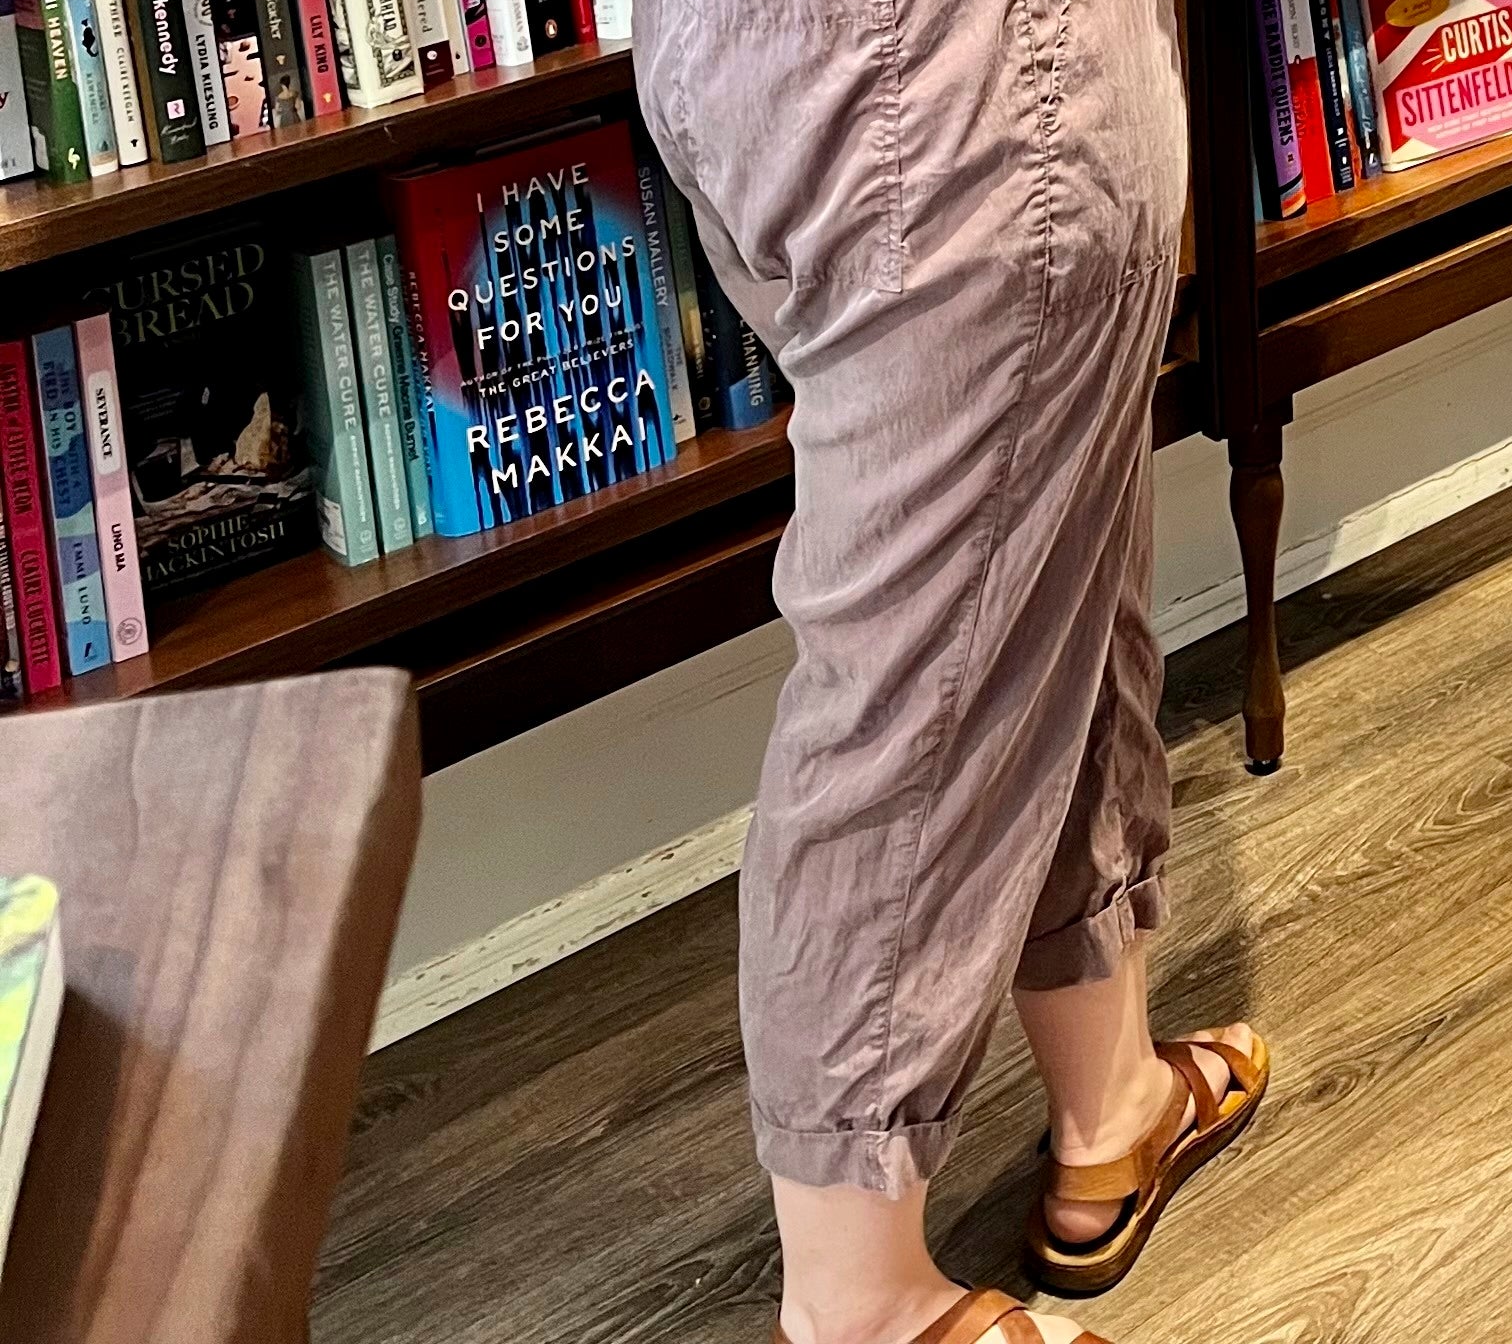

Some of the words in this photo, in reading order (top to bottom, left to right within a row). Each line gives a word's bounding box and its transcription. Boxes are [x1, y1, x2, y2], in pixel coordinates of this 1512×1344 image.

[47, 17, 68, 81] HEAVEN
[152, 0, 177, 76] kennedy
[1272, 86, 1294, 147] QUEENS
[476, 192, 484, 213] I
[502, 162, 590, 206] HAVE
[493, 208, 586, 253] SOME
[447, 236, 636, 313] QUESTIONS
[476, 312, 545, 350] FOR
[559, 285, 623, 323] YOU
[466, 368, 657, 453] REBECCA
[492, 417, 647, 495] MAKKAI
